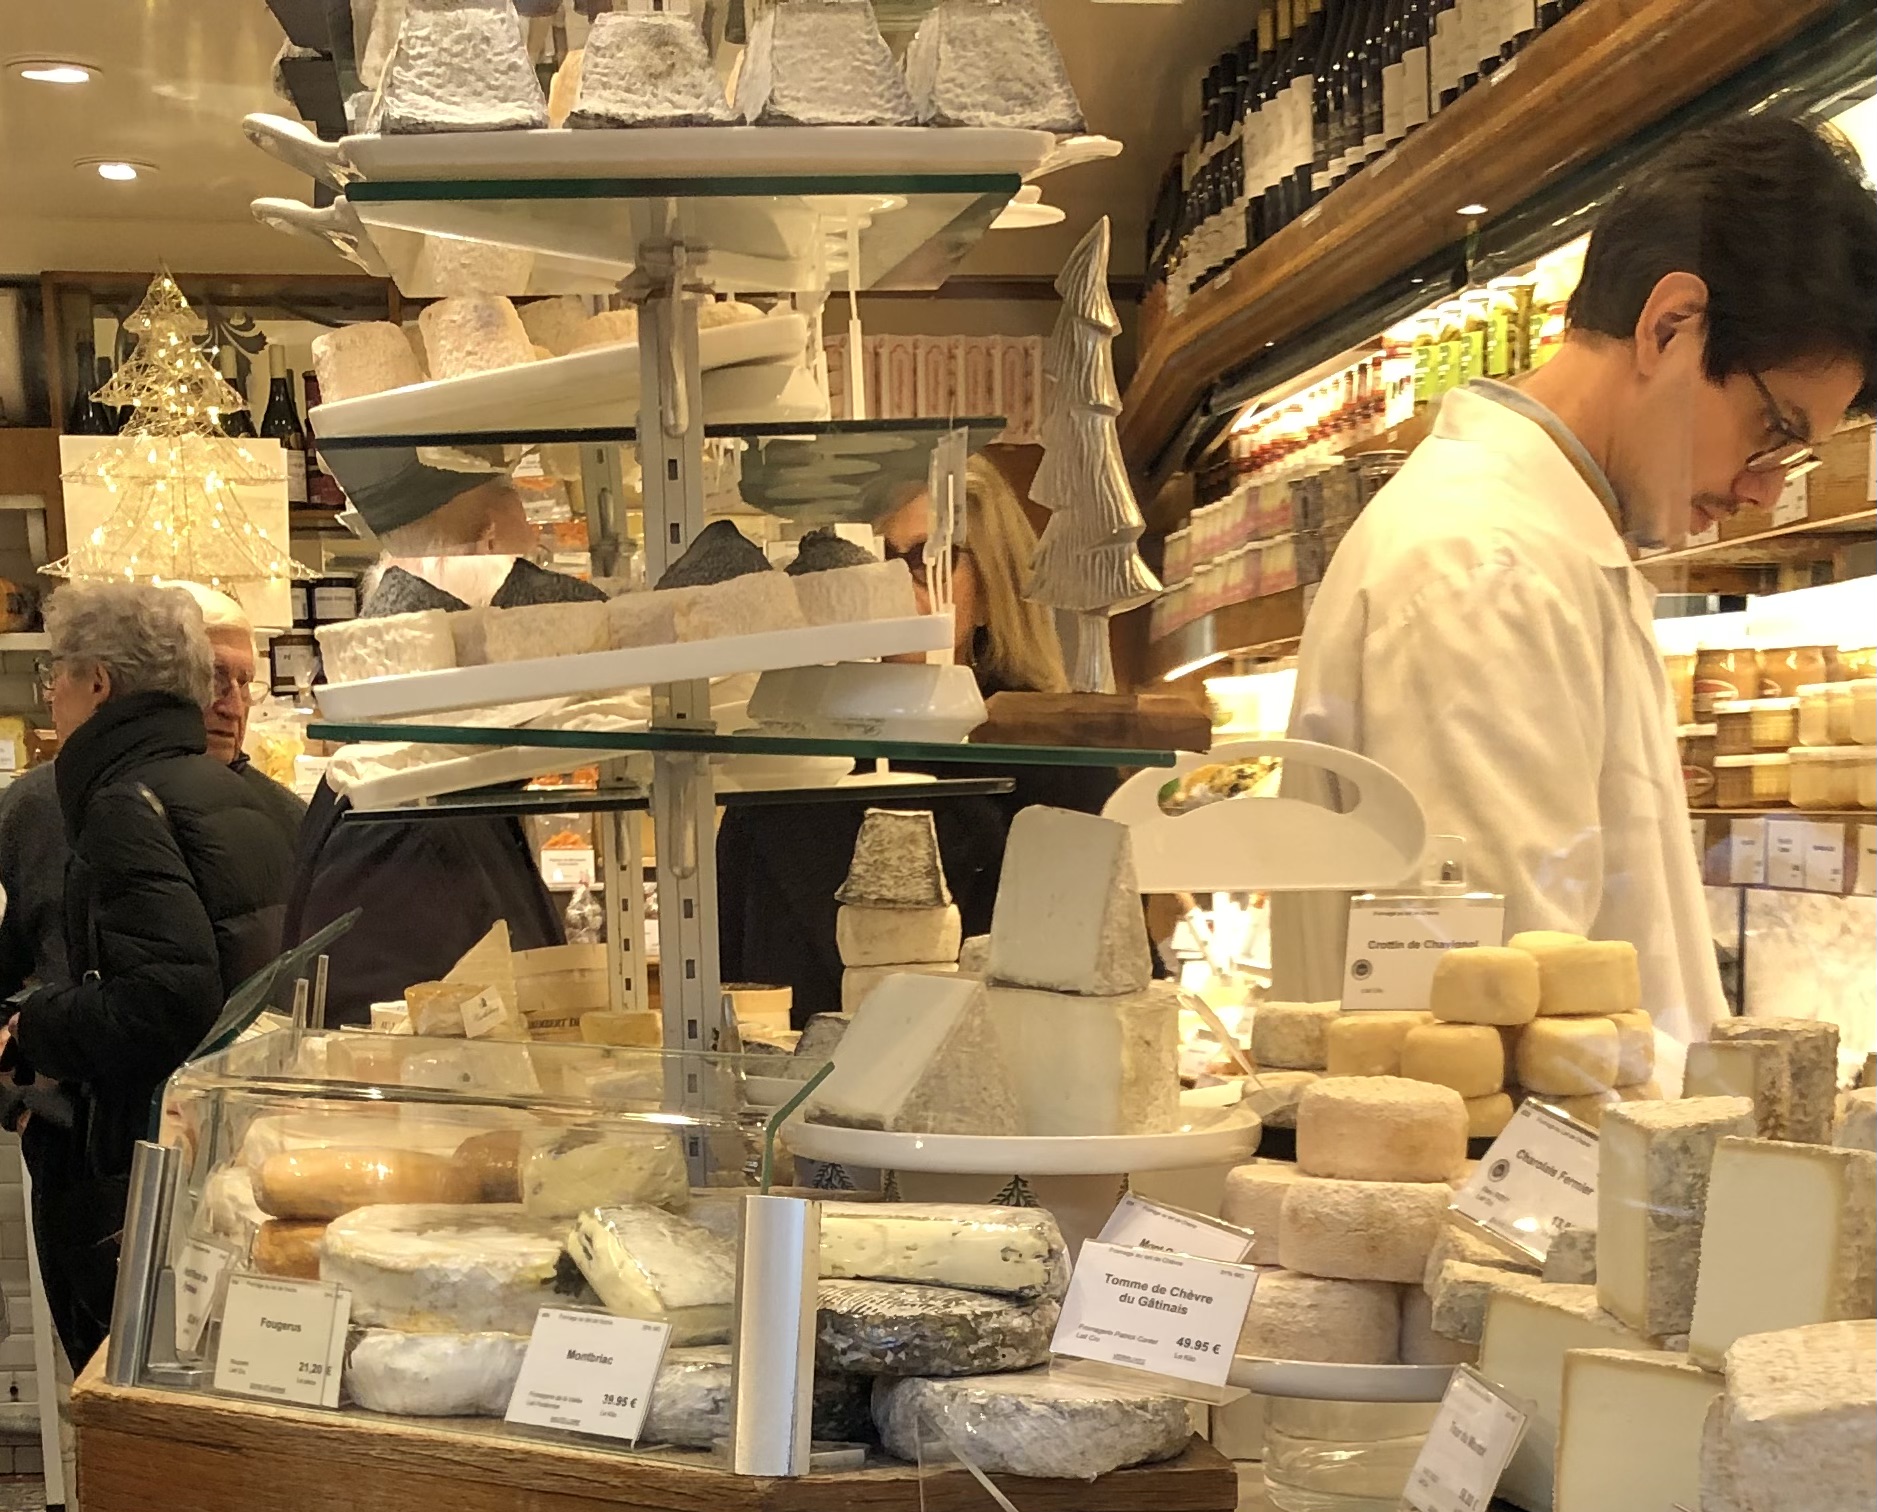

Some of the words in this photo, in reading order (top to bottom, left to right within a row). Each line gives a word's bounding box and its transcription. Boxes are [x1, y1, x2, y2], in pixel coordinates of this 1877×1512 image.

[1105, 1273, 1149, 1291] Tomme
[1151, 1284, 1167, 1295] de
[1169, 1286, 1213, 1305] Chèvre
[1118, 1293, 1135, 1304] du
[1137, 1295, 1189, 1315] Gâtinais
[260, 1317, 302, 1333] Fougerus
[1175, 1337, 1209, 1353] 49.95
[1212, 1344, 1222, 1355] €
[566, 1349, 614, 1366] Montbriac
